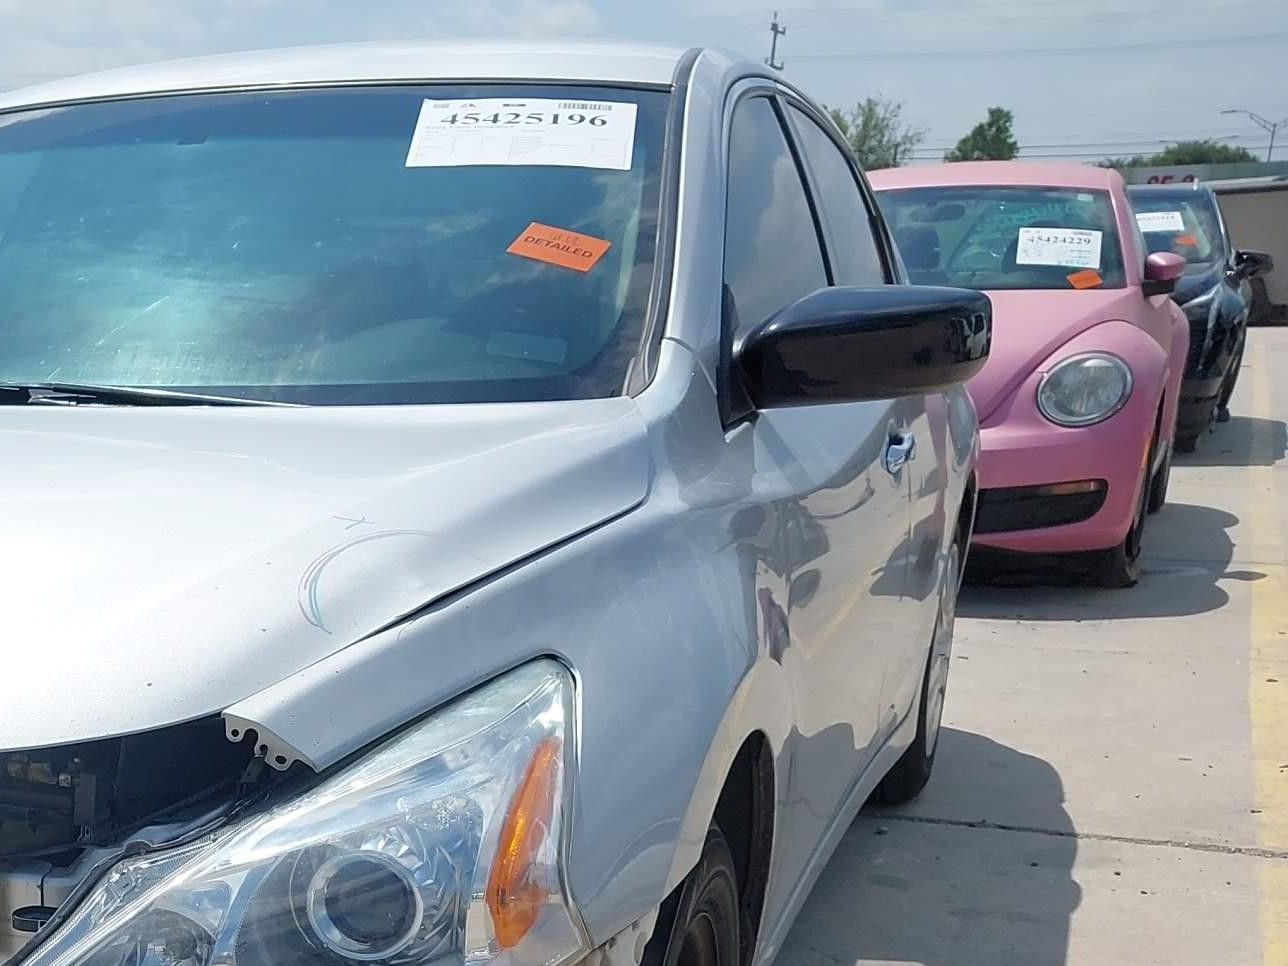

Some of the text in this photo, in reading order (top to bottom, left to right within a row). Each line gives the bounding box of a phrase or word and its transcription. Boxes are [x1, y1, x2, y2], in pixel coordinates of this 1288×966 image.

[439, 111, 609, 128] 45425196
[523, 235, 593, 258] DETAILED
[1026, 235, 1092, 245] 45424229
